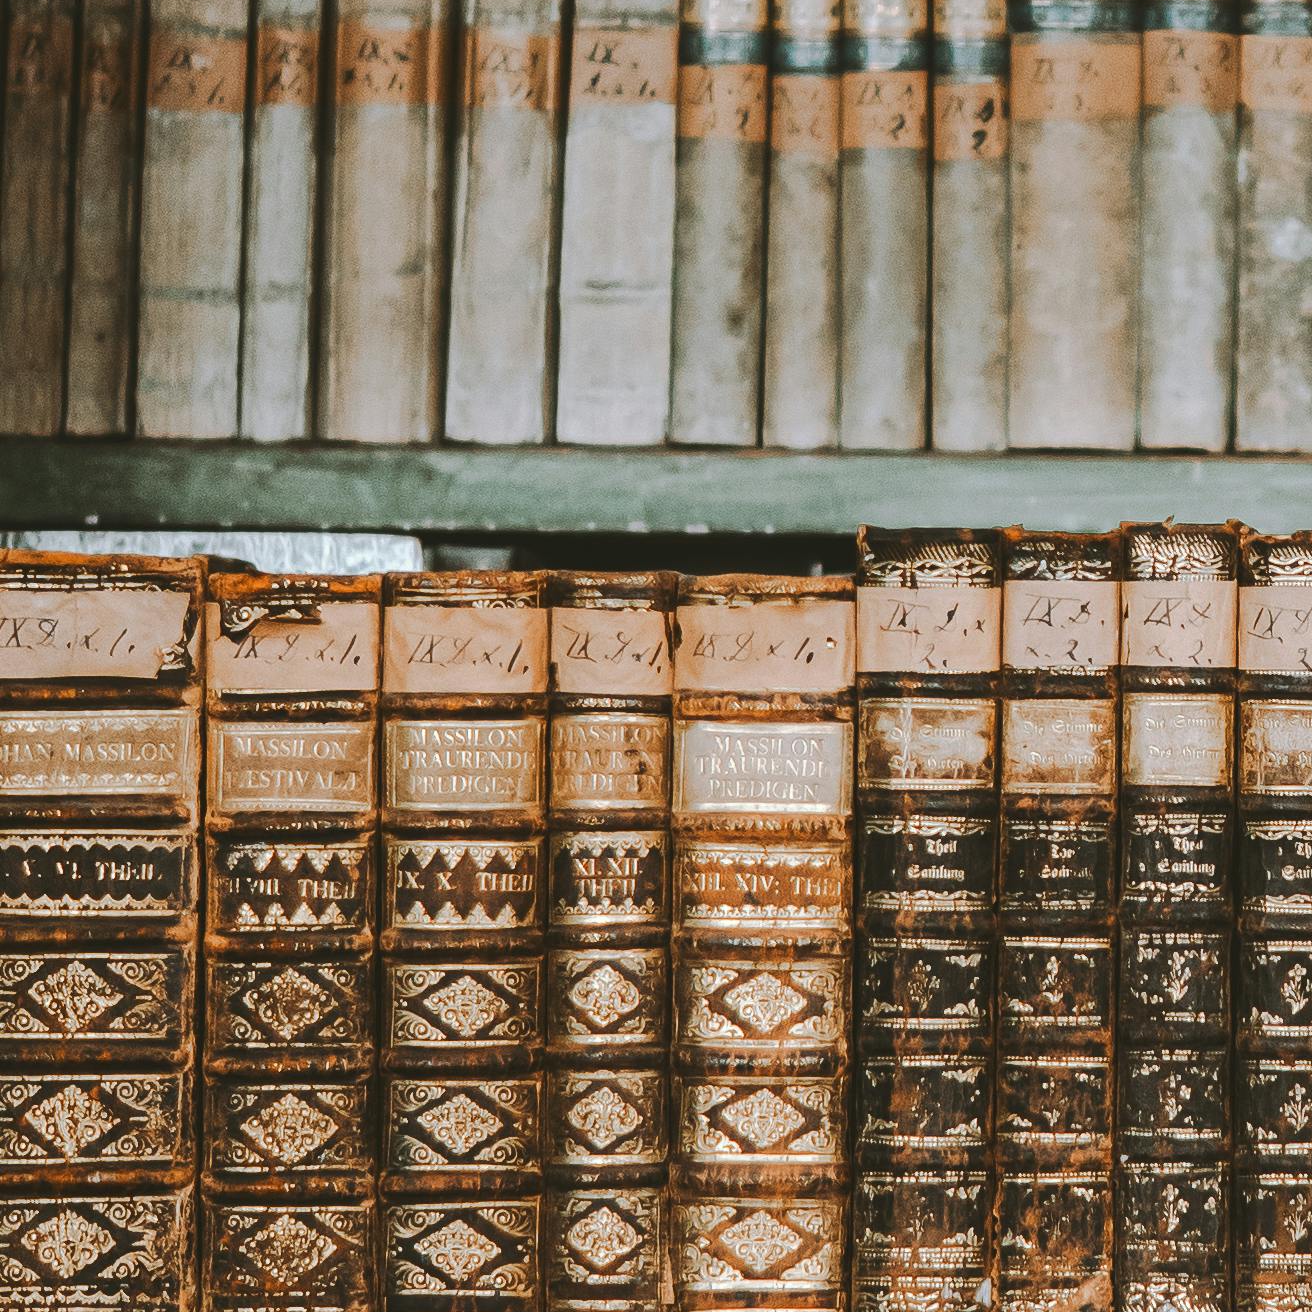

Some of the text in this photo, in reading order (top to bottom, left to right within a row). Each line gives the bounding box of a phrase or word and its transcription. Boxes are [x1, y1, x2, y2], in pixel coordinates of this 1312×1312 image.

[233, 736, 350, 762] MASSILON
[410, 727, 524, 748] MASSILON
[713, 735, 825, 758] MASSILON
[64, 740, 176, 764] MASSILON
